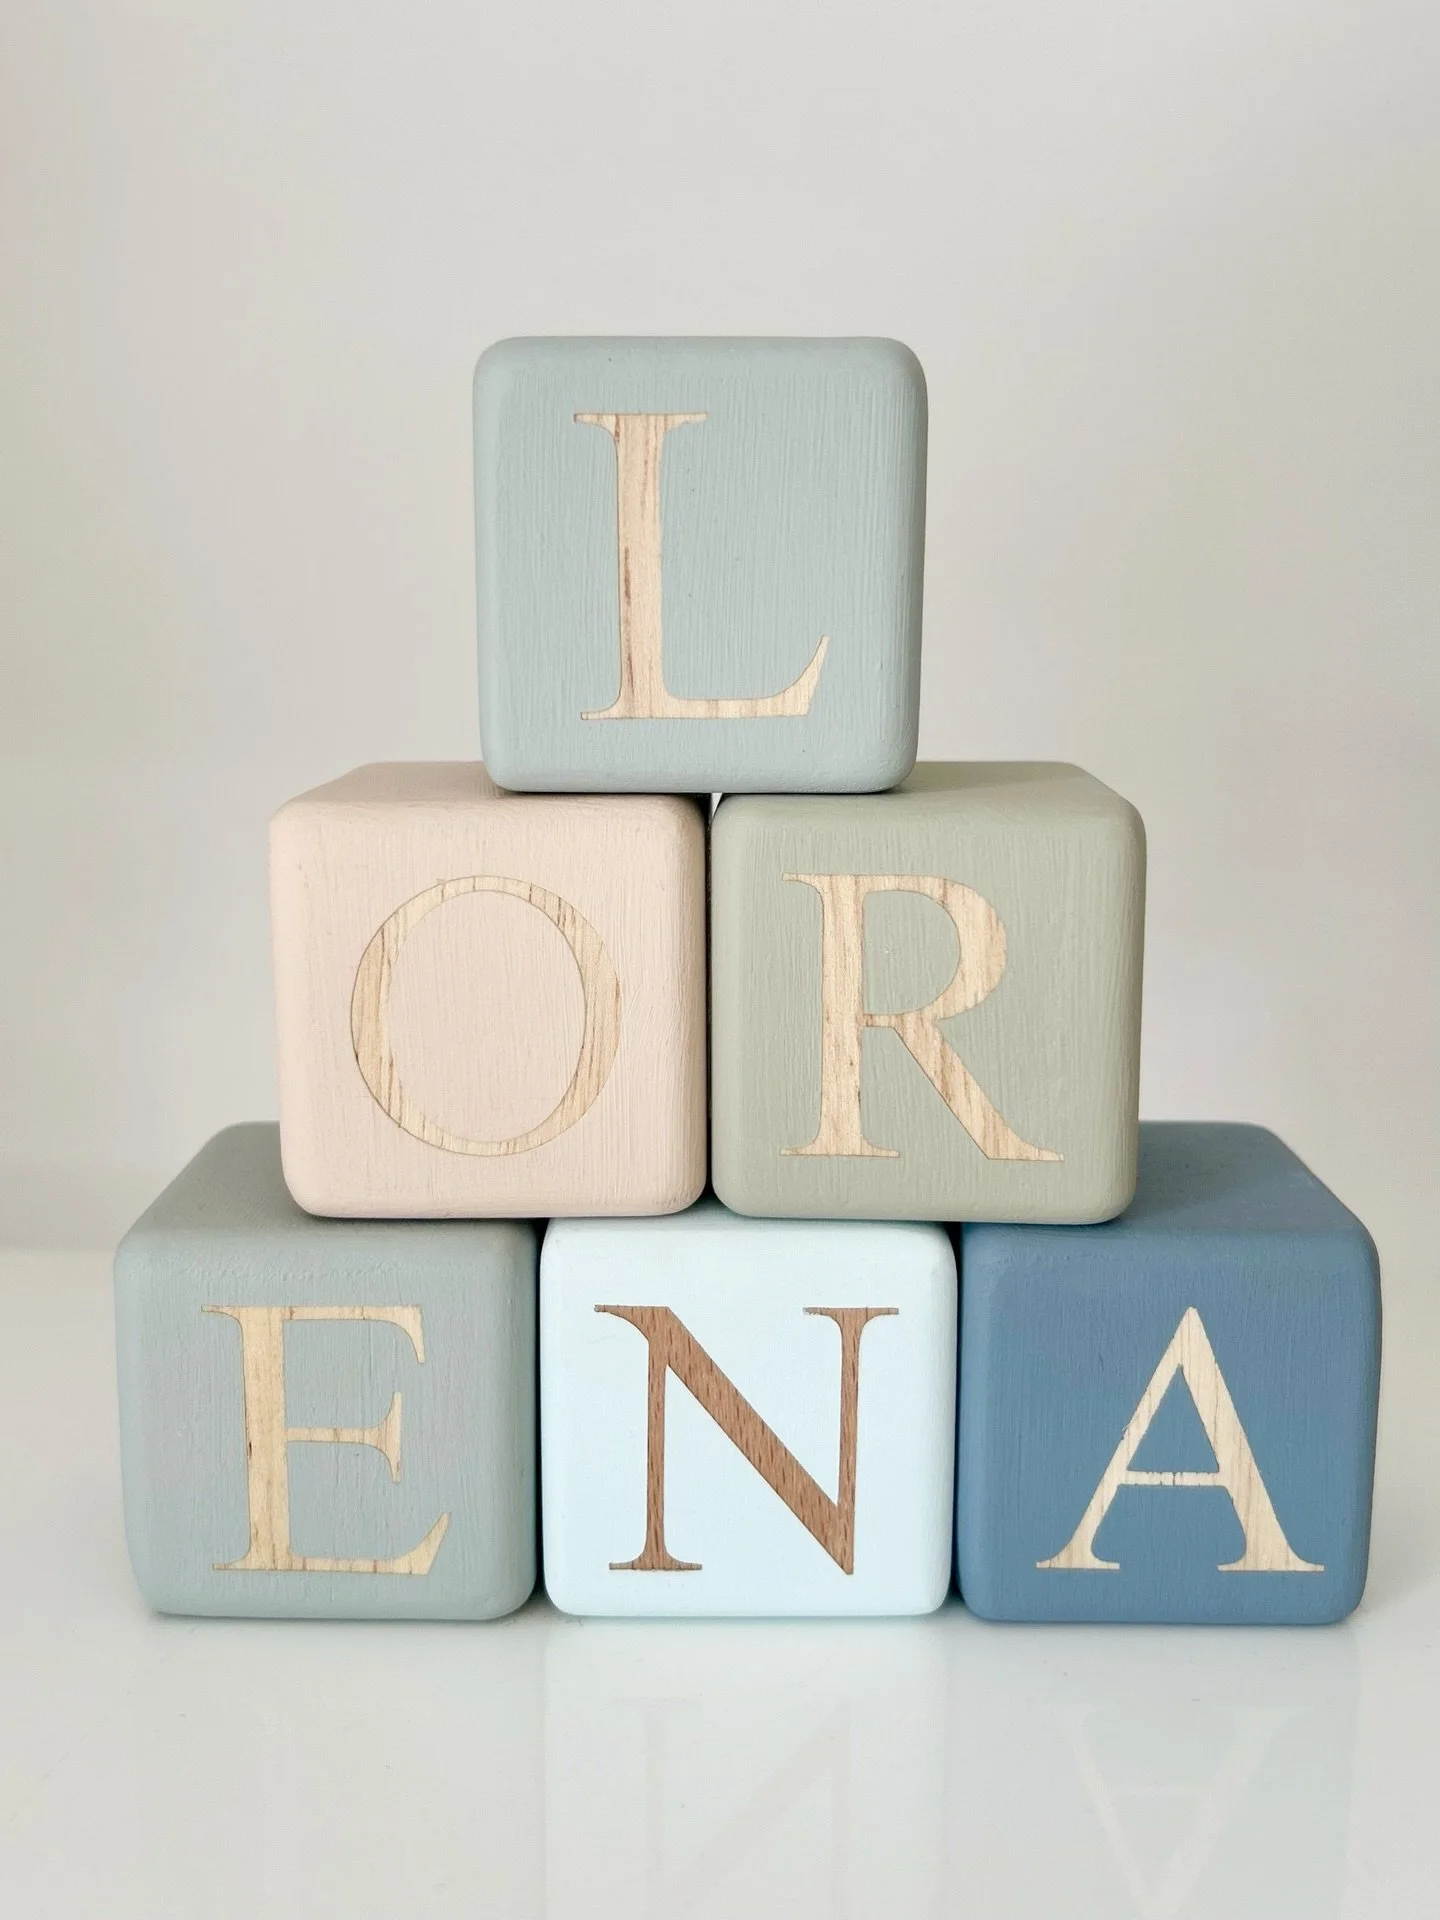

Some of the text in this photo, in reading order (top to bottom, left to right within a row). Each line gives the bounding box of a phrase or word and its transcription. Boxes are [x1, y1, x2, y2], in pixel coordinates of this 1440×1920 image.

[574, 412, 829, 720] L
[351, 875, 621, 1156] O
[781, 873, 1064, 1161] R
[202, 1303, 451, 1576] E
[595, 1305, 899, 1576] N
[1035, 1306, 1326, 1574] A
